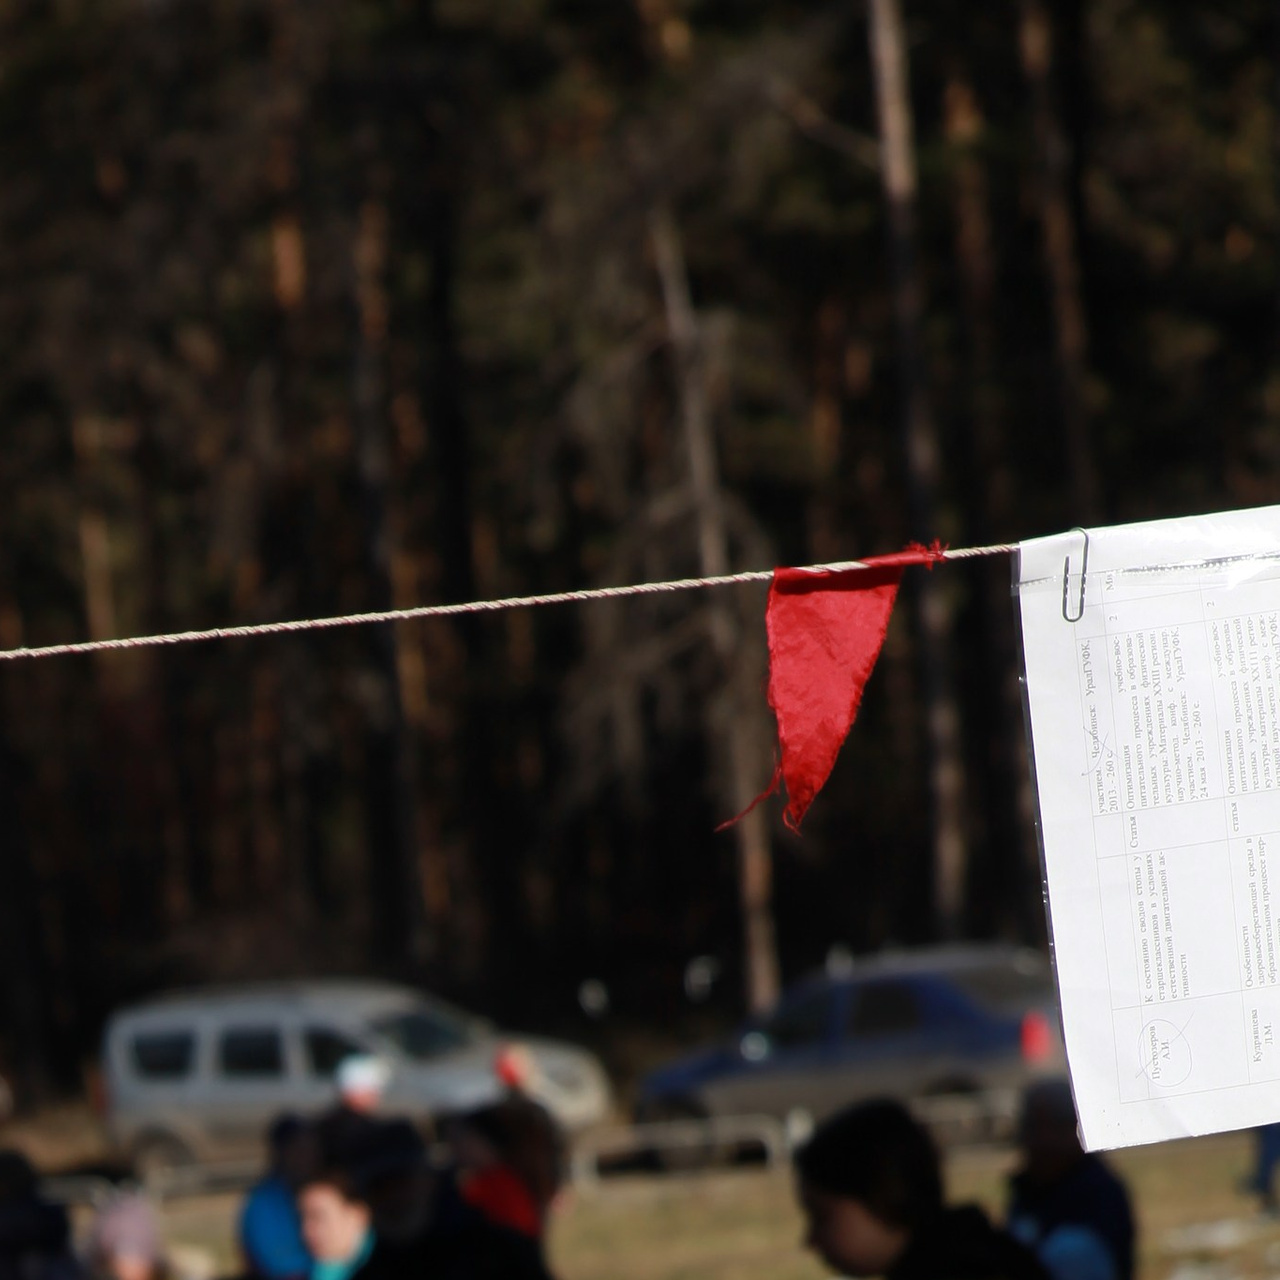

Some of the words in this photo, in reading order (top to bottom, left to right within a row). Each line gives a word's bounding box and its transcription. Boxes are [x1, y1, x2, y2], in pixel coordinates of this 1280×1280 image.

[1150, 631, 1161, 666] регион.
[1161, 629, 1172, 678] междунар.
[1212, 622, 1226, 677] учебно-вос-
[1223, 620, 1235, 665] образова-
[1233, 618, 1249, 673] физической
[1247, 617, 1258, 646] регио-
[1113, 636, 1126, 692] учебно-вос-
[1126, 634, 1137, 679] образова-
[1136, 632, 1151, 688] физической
[1131, 695, 1143, 738] процесса
[1167, 700, 1178, 726] конф.
[1180, 691, 1191, 745] Челябинск:
[1192, 710, 1202, 728] 260
[1193, 700, 1200, 708] с.
[1231, 681, 1243, 723] процесса
[1243, 681, 1257, 743] учреждениях
[1256, 686, 1267, 736] материалы
[1088, 705, 1101, 758] Челябинск:
[1144, 696, 1157, 758] учреждениях
[1157, 700, 1167, 753] Материалы
[1195, 737, 1205, 762] 2013.
[1105, 760, 1115, 777] 260
[1107, 750, 1113, 758] с.
[1124, 745, 1135, 809] Оптимизация
[1136, 744, 1147, 807] питательного
[1172, 735, 1185, 801] научно-метод.
[1187, 753, 1198, 799] участием.
[1224, 730, 1236, 794] Оптимизация
[1236, 728, 1248, 791] питательного
[1250, 751, 1259, 789] тельных
[1261, 740, 1273, 788] культуры:
[1093, 766, 1107, 813] участием.
[1108, 786, 1118, 811] 2013.
[1150, 766, 1160, 805] тельных
[1162, 756, 1174, 803] культуры:
[1199, 787, 1208, 798] 24
[1129, 816, 1138, 848] Статья
[1231, 802, 1239, 832] статья
[1134, 866, 1143, 895] стопы
[1146, 853, 1158, 896] условиях
[1261, 861, 1273, 902] процессе
[1138, 901, 1146, 933] сводов
[1158, 869, 1172, 932] двигательной
[1142, 938, 1152, 989] состоянию
[1152, 914, 1166, 1000] старшеклассников
[1164, 936, 1177, 999] естественной
[1180, 954, 1190, 997] тивности
[1242, 926, 1253, 987] Особенности
[1144, 994, 1153, 1003] К
[1251, 1009, 1263, 1062] Кудрявцева
